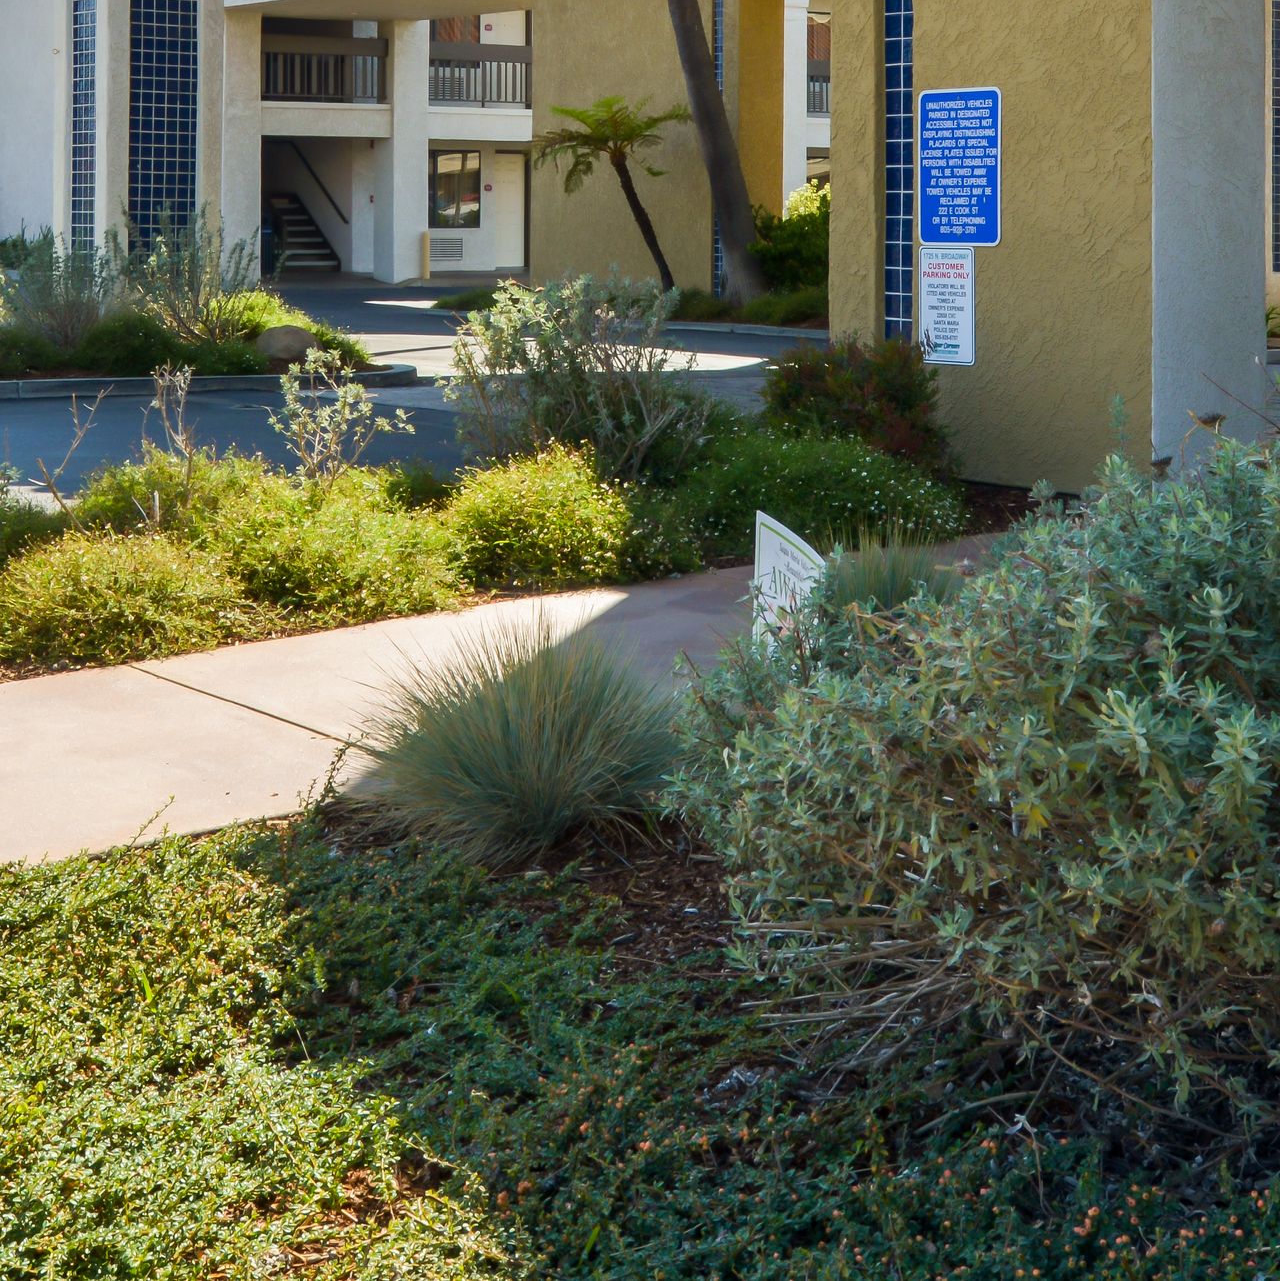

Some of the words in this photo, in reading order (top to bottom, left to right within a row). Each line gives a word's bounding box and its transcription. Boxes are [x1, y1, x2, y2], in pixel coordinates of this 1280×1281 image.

[926, 101, 965, 109] UNAUTHORIZED
[958, 109, 990, 117] DESIGNATED
[926, 120, 957, 128] ACCESSIBLE
[923, 130, 952, 138] DISPLAYING
[954, 129, 995, 137] DISTINGUISHING
[944, 149, 963, 157] PLATES
[923, 159, 946, 167] PERSONS
[963, 158, 995, 166] DISABILITIES
